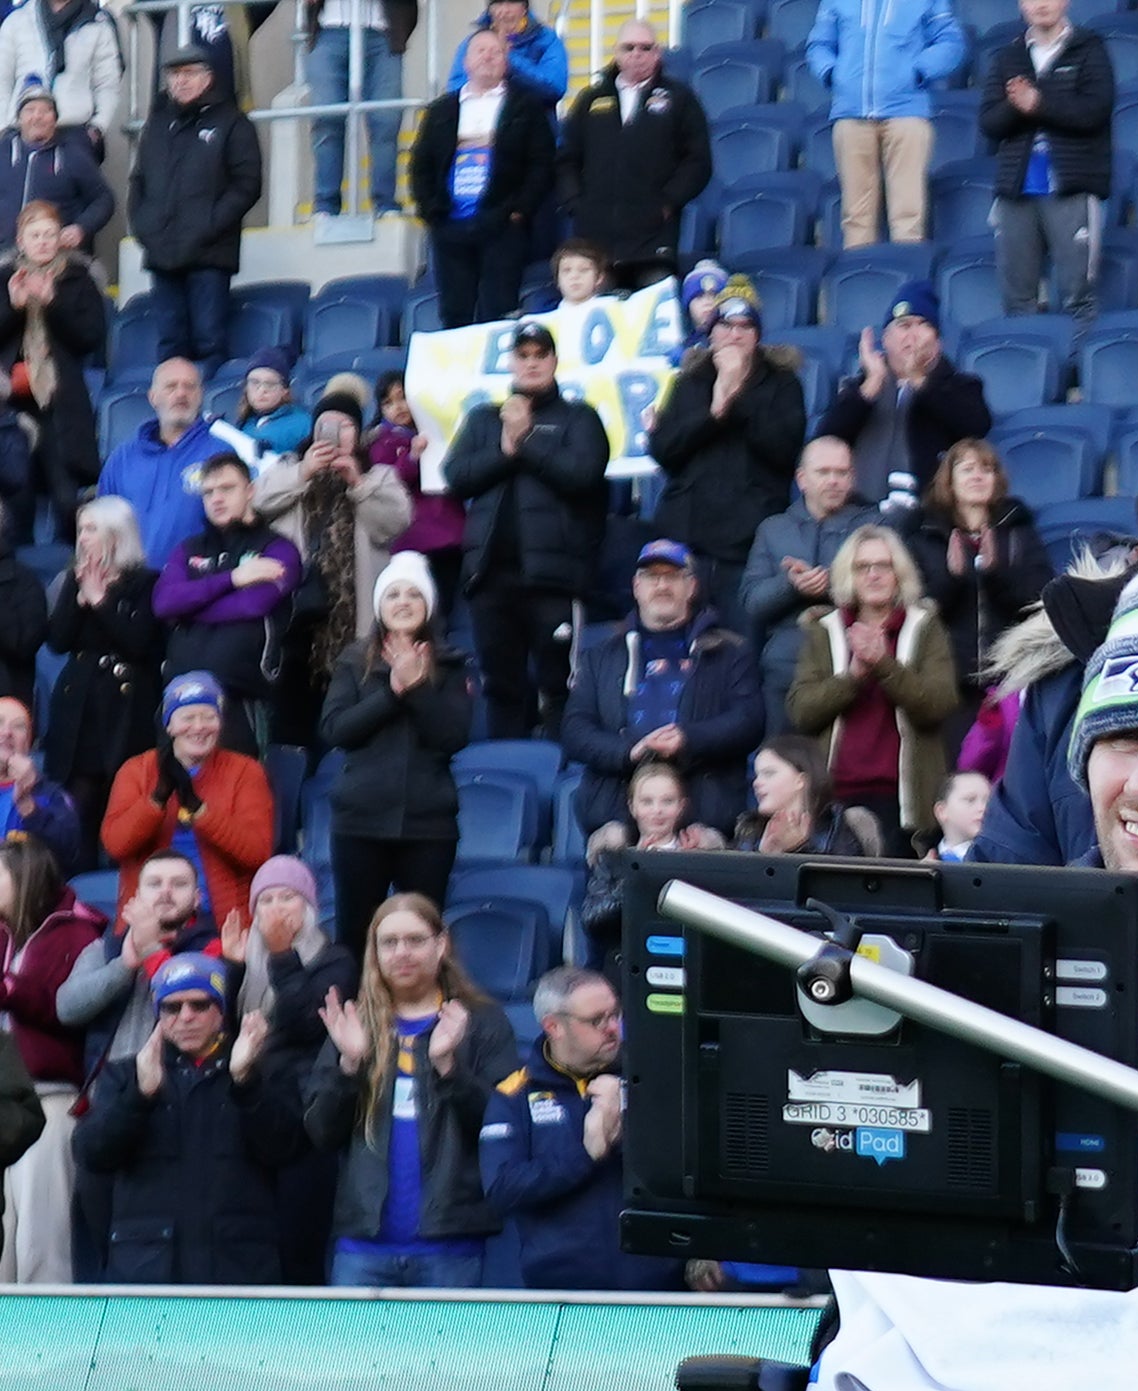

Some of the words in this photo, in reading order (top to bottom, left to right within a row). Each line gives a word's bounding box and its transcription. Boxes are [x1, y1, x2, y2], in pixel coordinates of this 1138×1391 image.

[785, 1104, 831, 1120] GRID
[836, 1105, 847, 1121] 3
[860, 1131, 900, 1153] Pad
